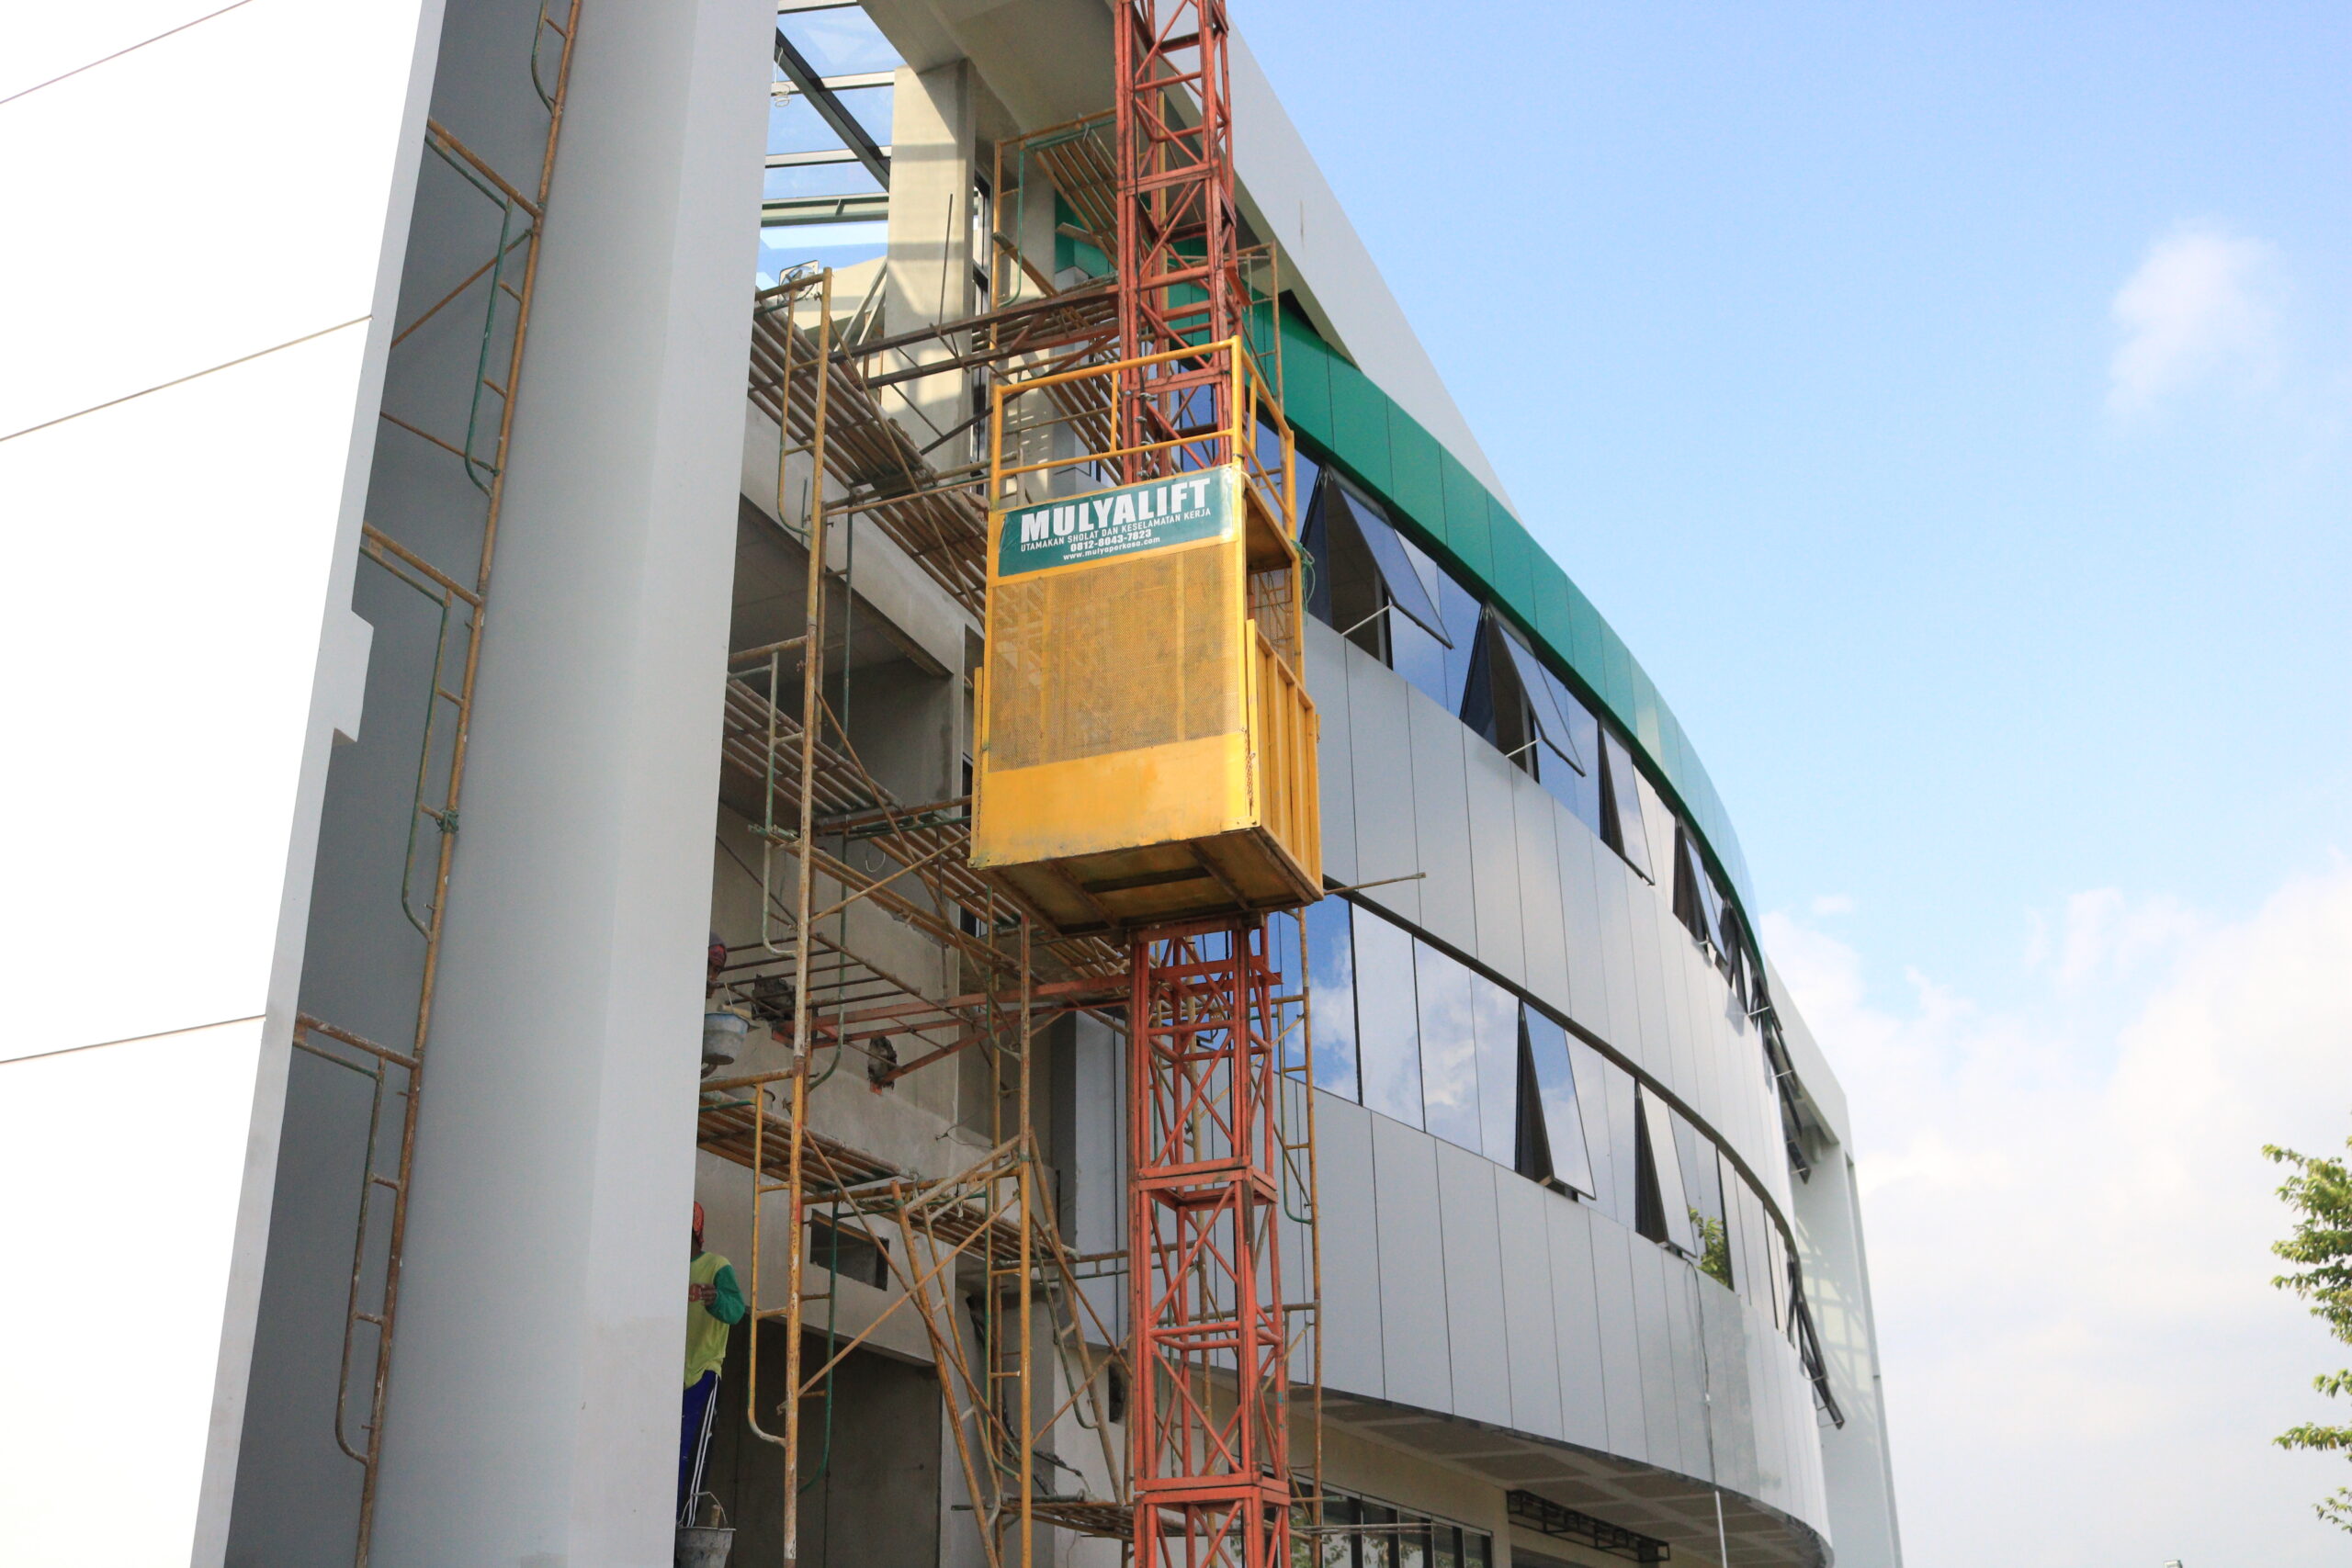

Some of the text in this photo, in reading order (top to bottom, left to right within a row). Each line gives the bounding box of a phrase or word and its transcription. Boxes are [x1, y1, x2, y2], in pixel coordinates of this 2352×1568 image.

[1021, 478, 1211, 544] MULYALIFT
[1021, 508, 1212, 552] UTAMAKAN SHOLAT DAN KESELAMATAN KERJA
[1070, 529, 1152, 552] 0812-8043-7823
[1063, 536, 1161, 561] www.mulyaperkasa.com
